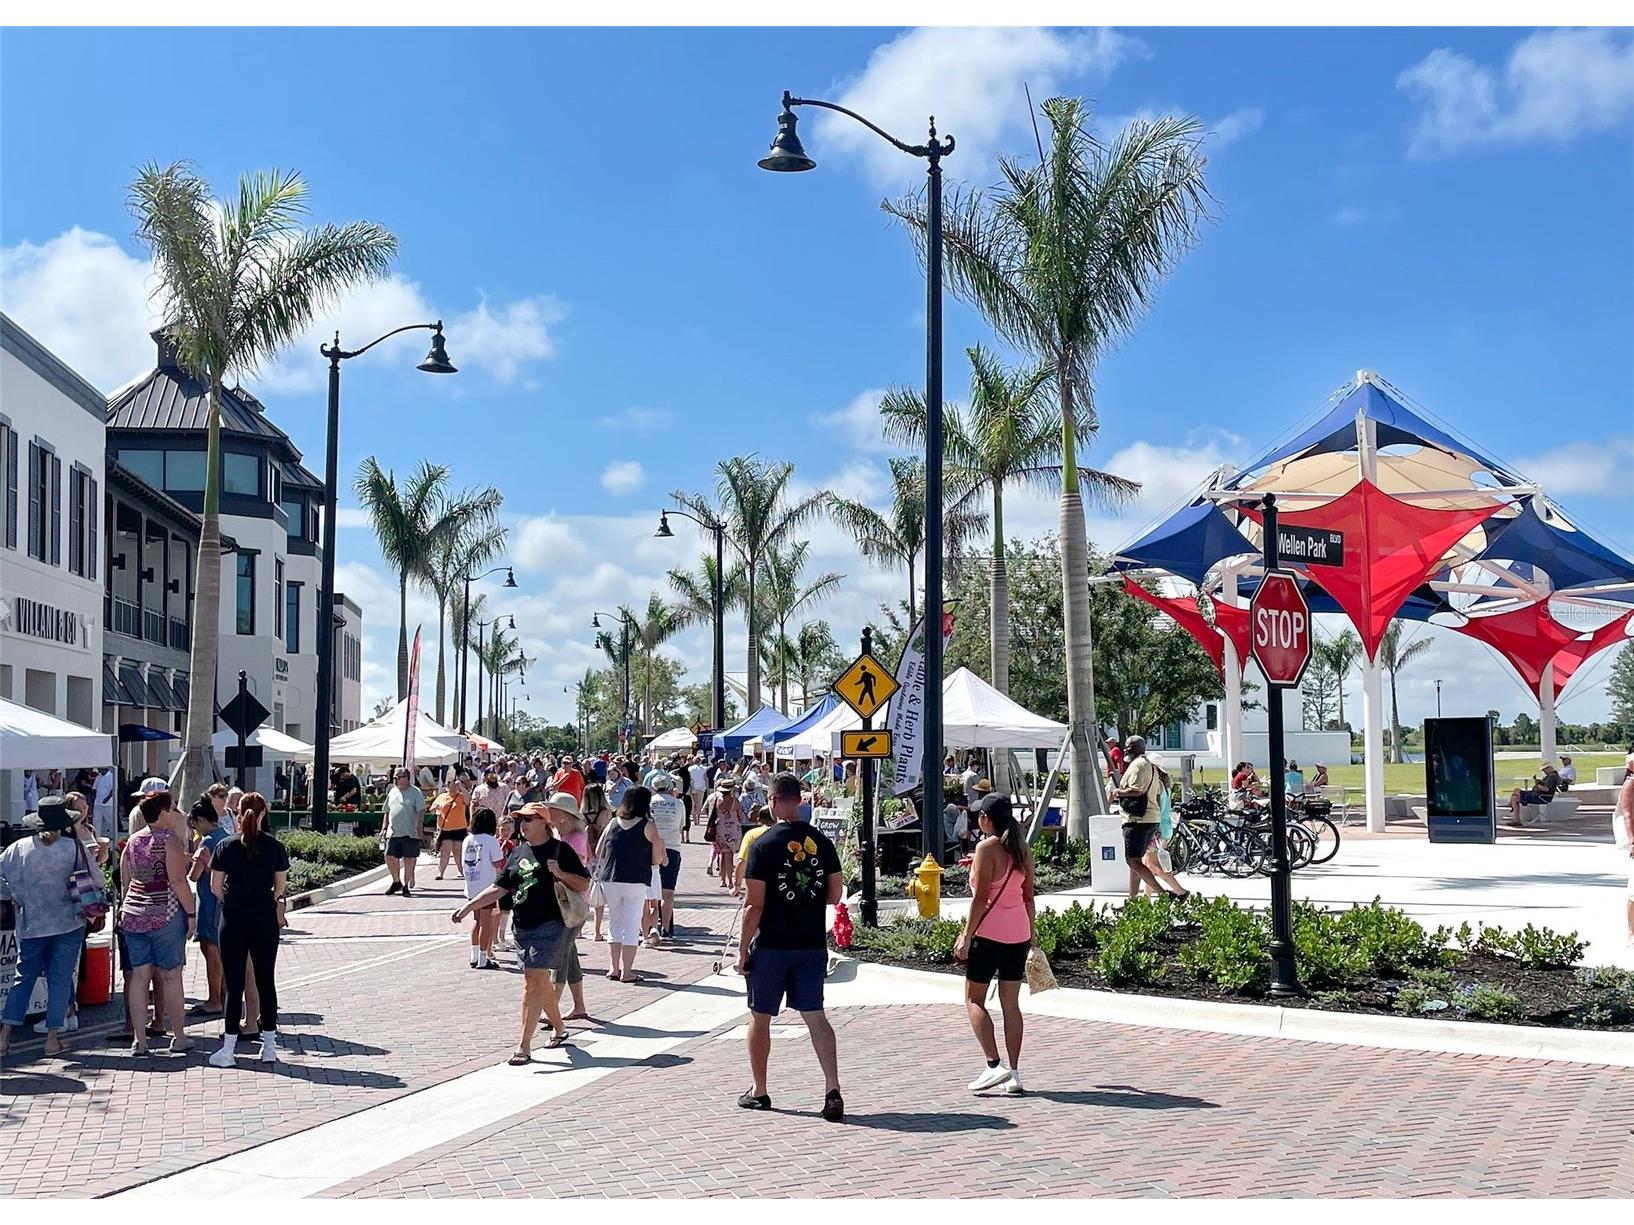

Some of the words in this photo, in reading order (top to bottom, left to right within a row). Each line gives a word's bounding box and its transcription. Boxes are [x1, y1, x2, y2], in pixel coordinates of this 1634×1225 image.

[1278, 532, 1306, 557] Wellen
[1307, 536, 1327, 559] Park
[1329, 533, 1342, 544] BLVD
[15, 596, 55, 640] VILLANI
[64, 611, 77, 645] CO
[1256, 607, 1305, 649] STOP
[908, 693, 922, 706] &
[902, 709, 919, 742] Herb
[895, 745, 914, 785] Plants
[820, 821, 840, 830] GROW
[810, 857, 824, 899] OBEY
